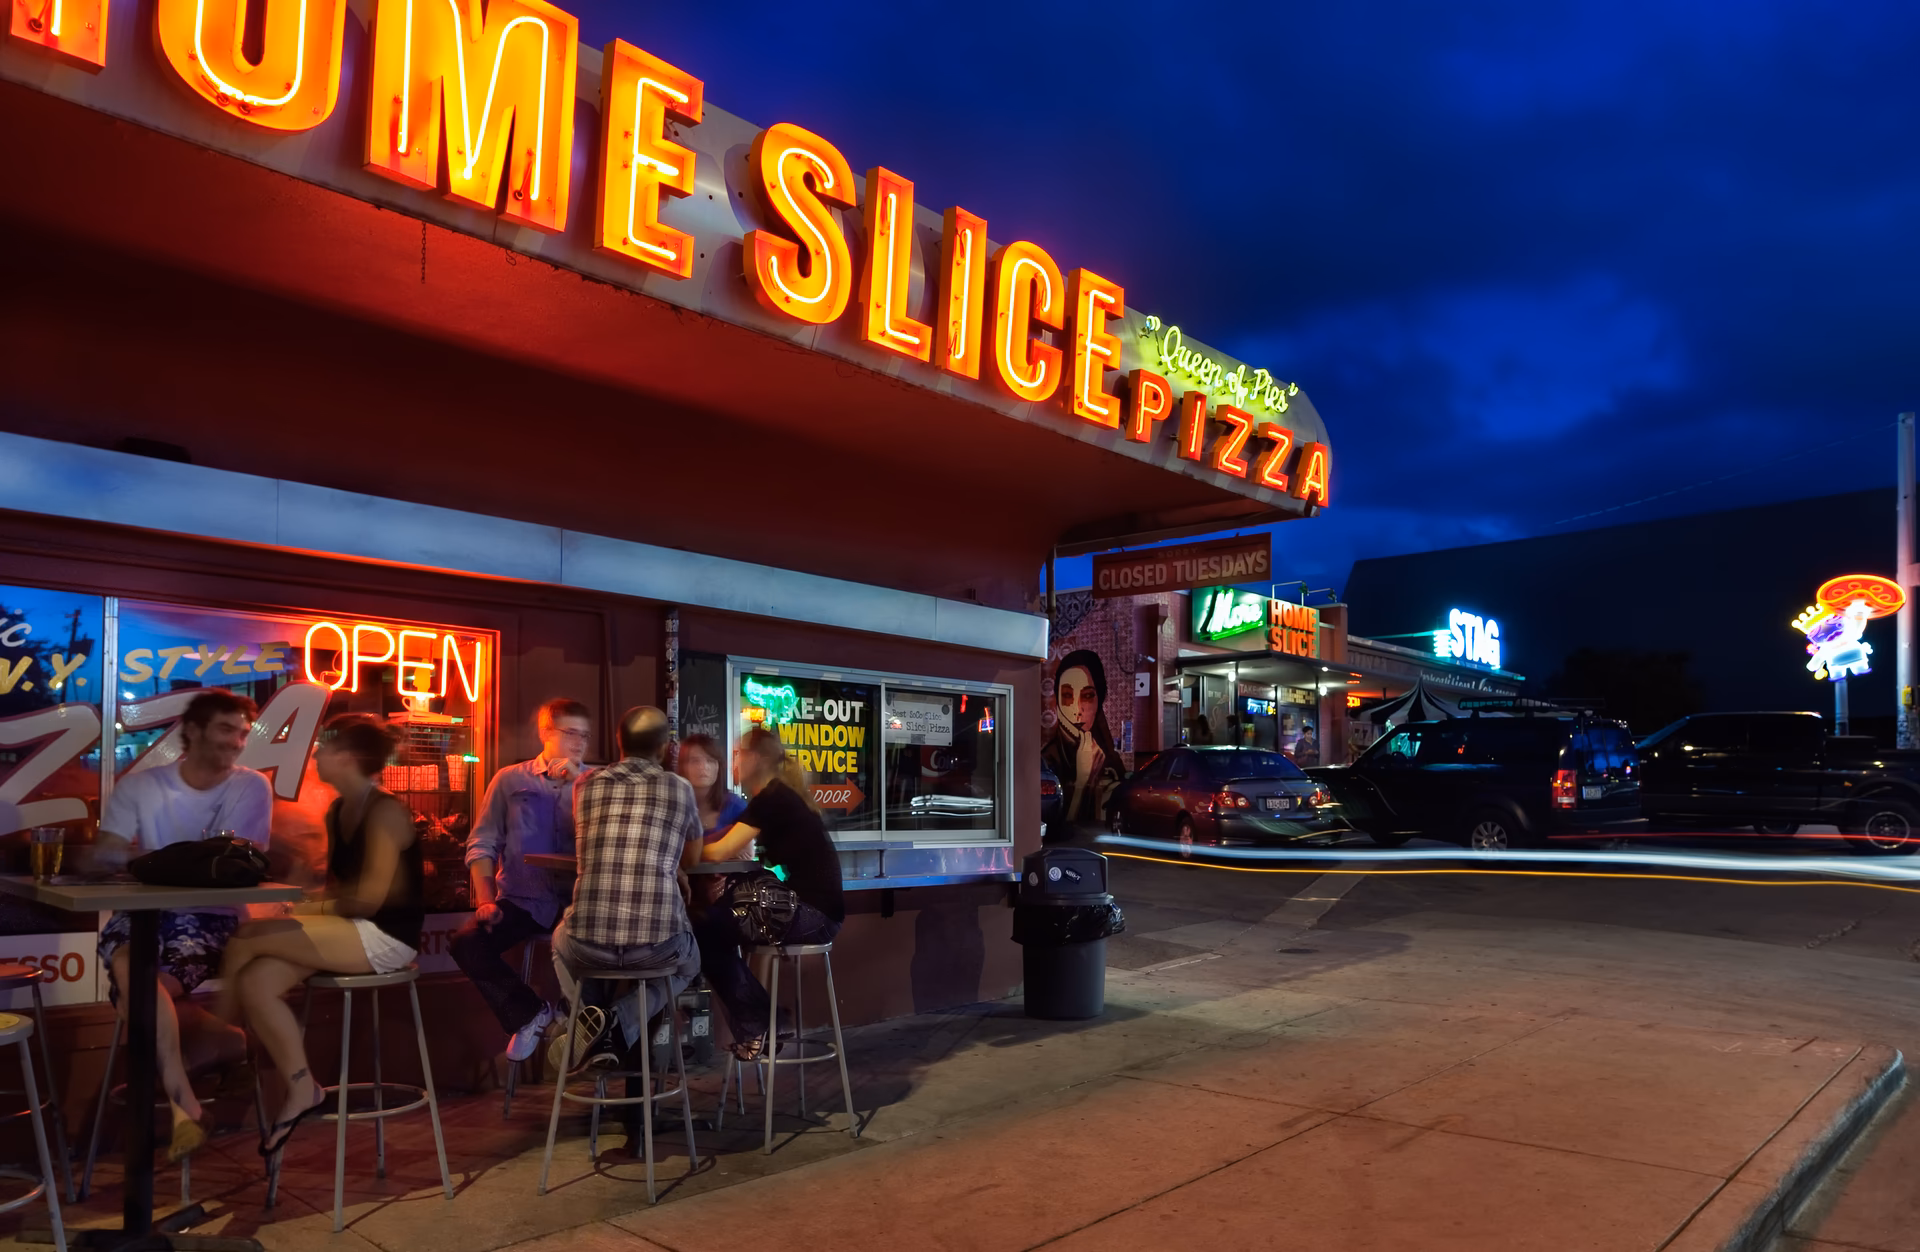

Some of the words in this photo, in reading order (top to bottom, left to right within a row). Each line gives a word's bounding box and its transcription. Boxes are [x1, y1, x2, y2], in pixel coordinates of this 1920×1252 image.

[8, 0, 703, 279] OME
[743, 122, 1124, 428] SLICE
[1225, 364, 1248, 409] of
[1125, 368, 1329, 508] PIZZA
[1100, 563, 1168, 590] CLOSED
[1172, 550, 1268, 583] TUESDAYS
[1200, 588, 1263, 633] More
[1268, 600, 1317, 633] HOME
[1268, 627, 1317, 659] SLICE
[1449, 608, 1500, 669] STAG
[119, 641, 291, 684] STYLE
[305, 621, 482, 703] OPEN
[681, 694, 719, 724] More
[892, 709, 907, 719] Best
[909, 710, 923, 720] SoCo
[924, 711, 942, 721] Slice
[906, 721, 926, 733] Slice
[929, 723, 951, 734] Pizza
[777, 723, 865, 748] WINDOW
[813, 789, 852, 804] DOOR
